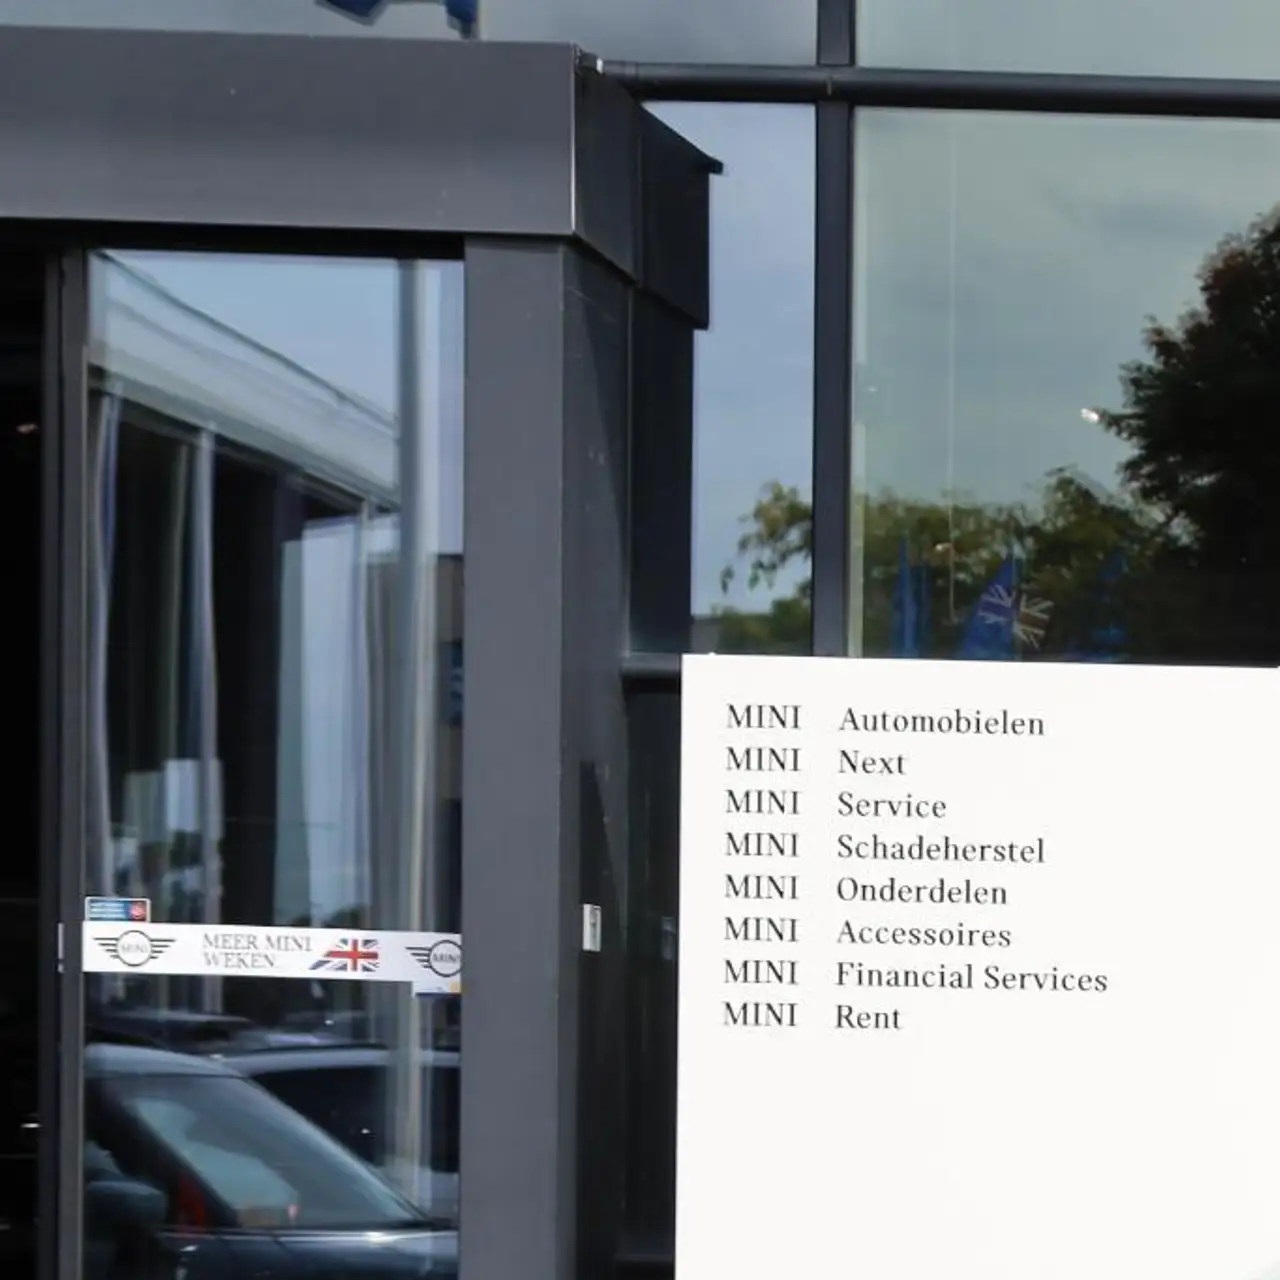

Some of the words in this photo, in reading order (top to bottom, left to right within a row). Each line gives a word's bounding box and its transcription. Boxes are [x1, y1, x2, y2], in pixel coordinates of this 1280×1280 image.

[728, 704, 800, 729] MINI
[840, 707, 1045, 736] Automobielen
[727, 746, 800, 772] MINI
[838, 750, 906, 775] Next
[727, 789, 800, 815] MINI
[837, 792, 947, 818] Service
[726, 831, 799, 858] MINI
[837, 834, 1045, 863] Schadeherstel
[726, 874, 799, 900] MINI
[837, 877, 1008, 905] Onderdelen
[203, 933, 258, 950] MEER
[265, 935, 312, 951] MINI
[724, 916, 799, 943] MINI
[838, 920, 1012, 947] Accessoires
[724, 959, 798, 985] MINI
[836, 962, 973, 989] Financial
[984, 965, 1108, 992] Services
[723, 1001, 798, 1028] MINI
[836, 1004, 901, 1030] Rent
